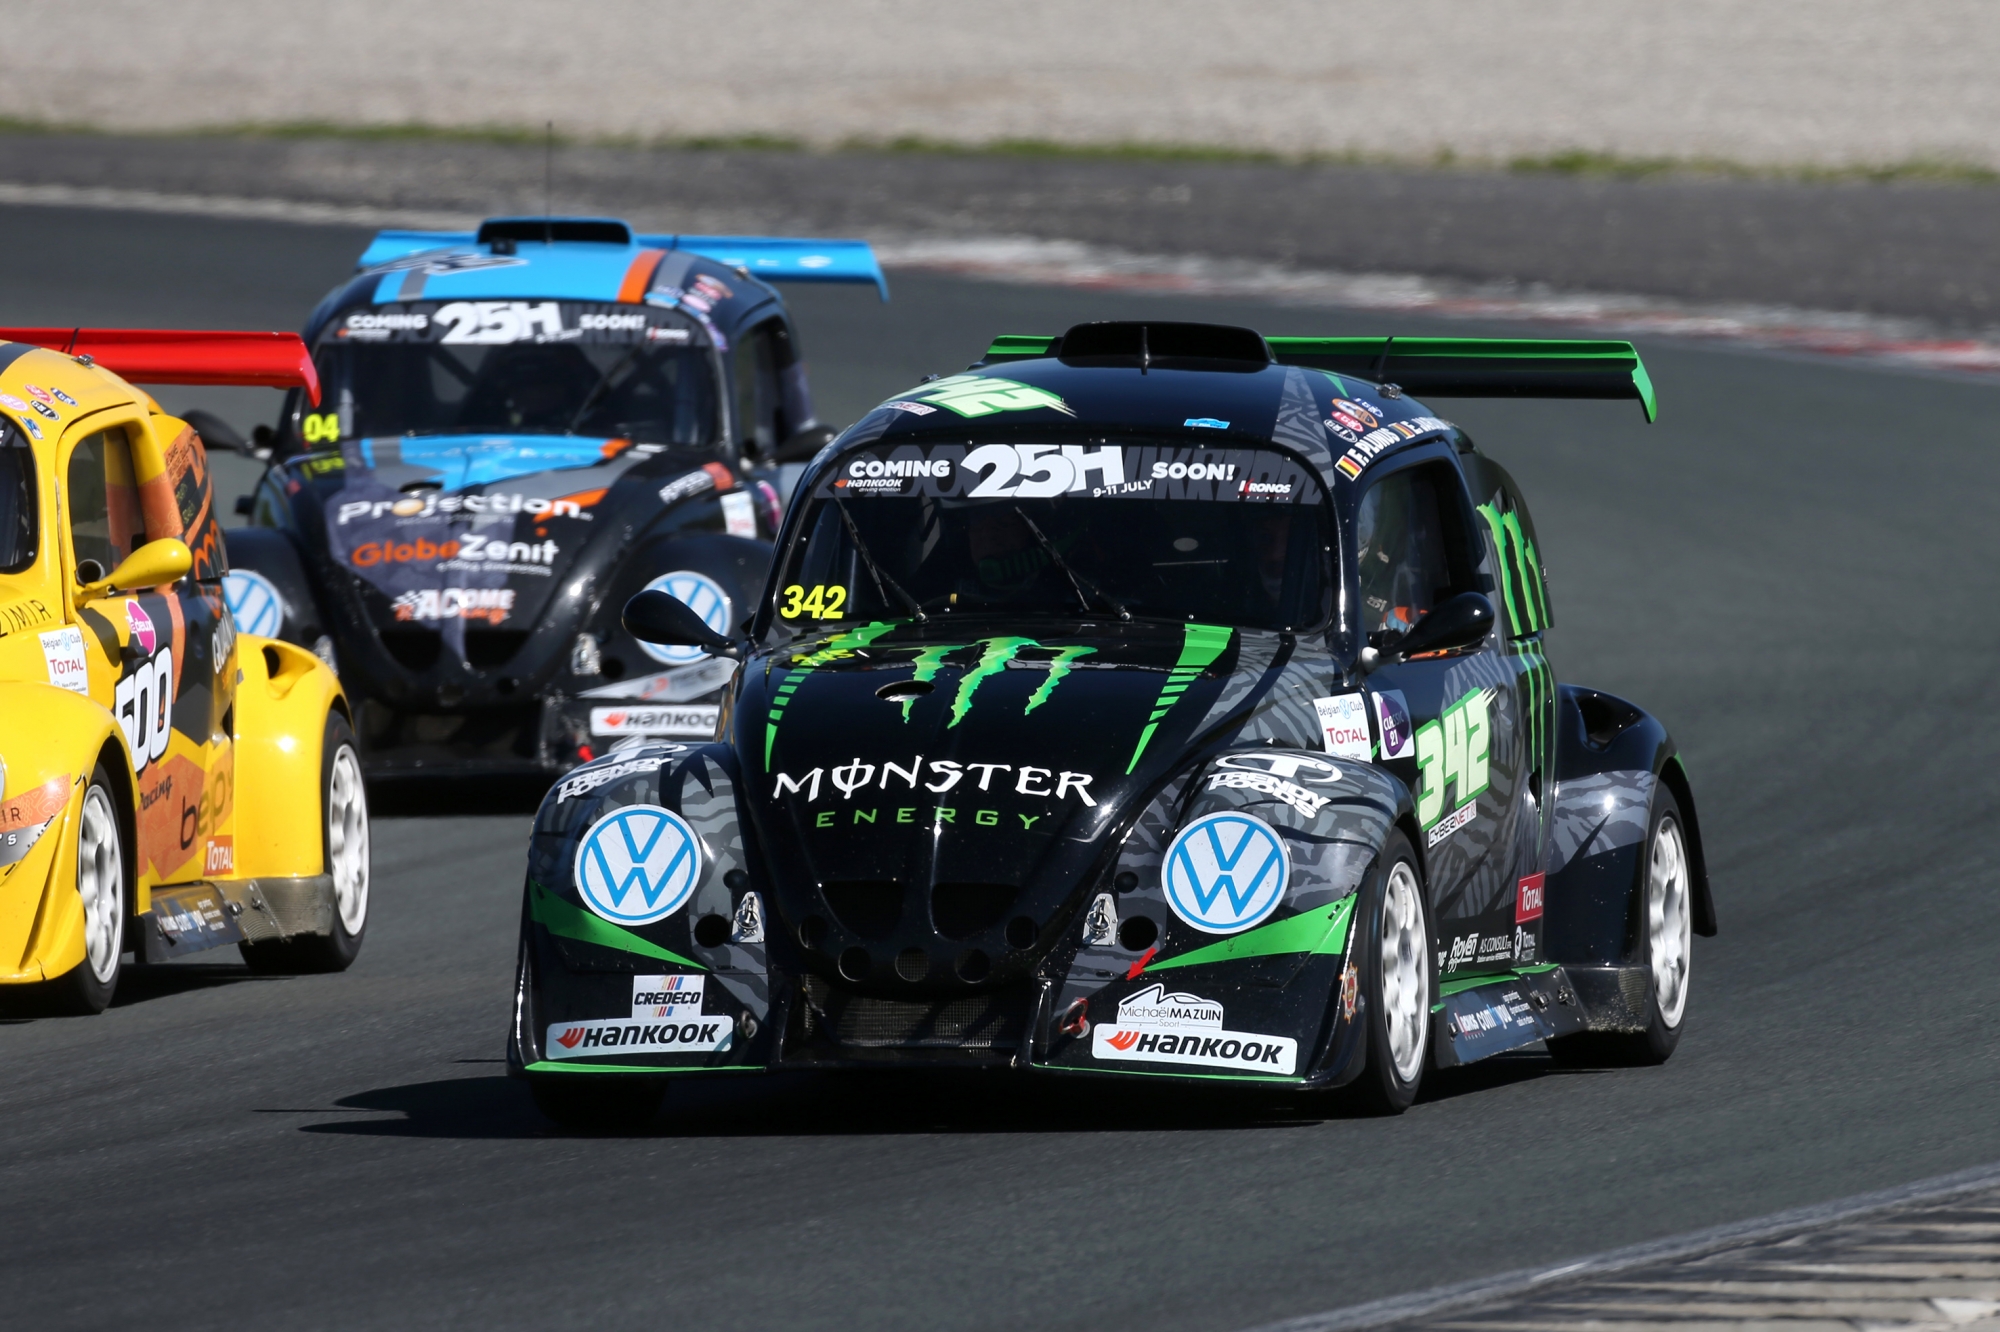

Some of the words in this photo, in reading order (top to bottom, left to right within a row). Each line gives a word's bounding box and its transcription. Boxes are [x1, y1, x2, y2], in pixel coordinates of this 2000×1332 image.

[347, 313, 428, 330] COMING
[432, 301, 563, 344] 25H
[849, 460, 951, 478] COMING
[960, 444, 1125, 498] 25H
[1151, 461, 1236, 481] SOON!
[1092, 485, 1118, 498] 9-11
[1121, 479, 1153, 494] JULY
[780, 584, 847, 619] 342
[42, 637, 63, 650] Belgian
[70, 633, 82, 644] Club
[50, 658, 85, 676] TOTAL
[115, 646, 173, 773] 500
[1317, 704, 1341, 718] Belgian
[1349, 700, 1364, 712] Club
[1326, 727, 1367, 745] TOTAL
[1389, 729, 1399, 747] 21
[1417, 688, 1495, 828] 342
[557, 757, 675, 790] TRENDY
[1208, 771, 1332, 810] TRENDY
[1208, 779, 1318, 819] FOODS
[816, 806, 1040, 830] ENERGY
[1522, 885, 1543, 912] TOTAL
[633, 991, 702, 1005] CREDECO
[1158, 1019, 1180, 1028] Sport
